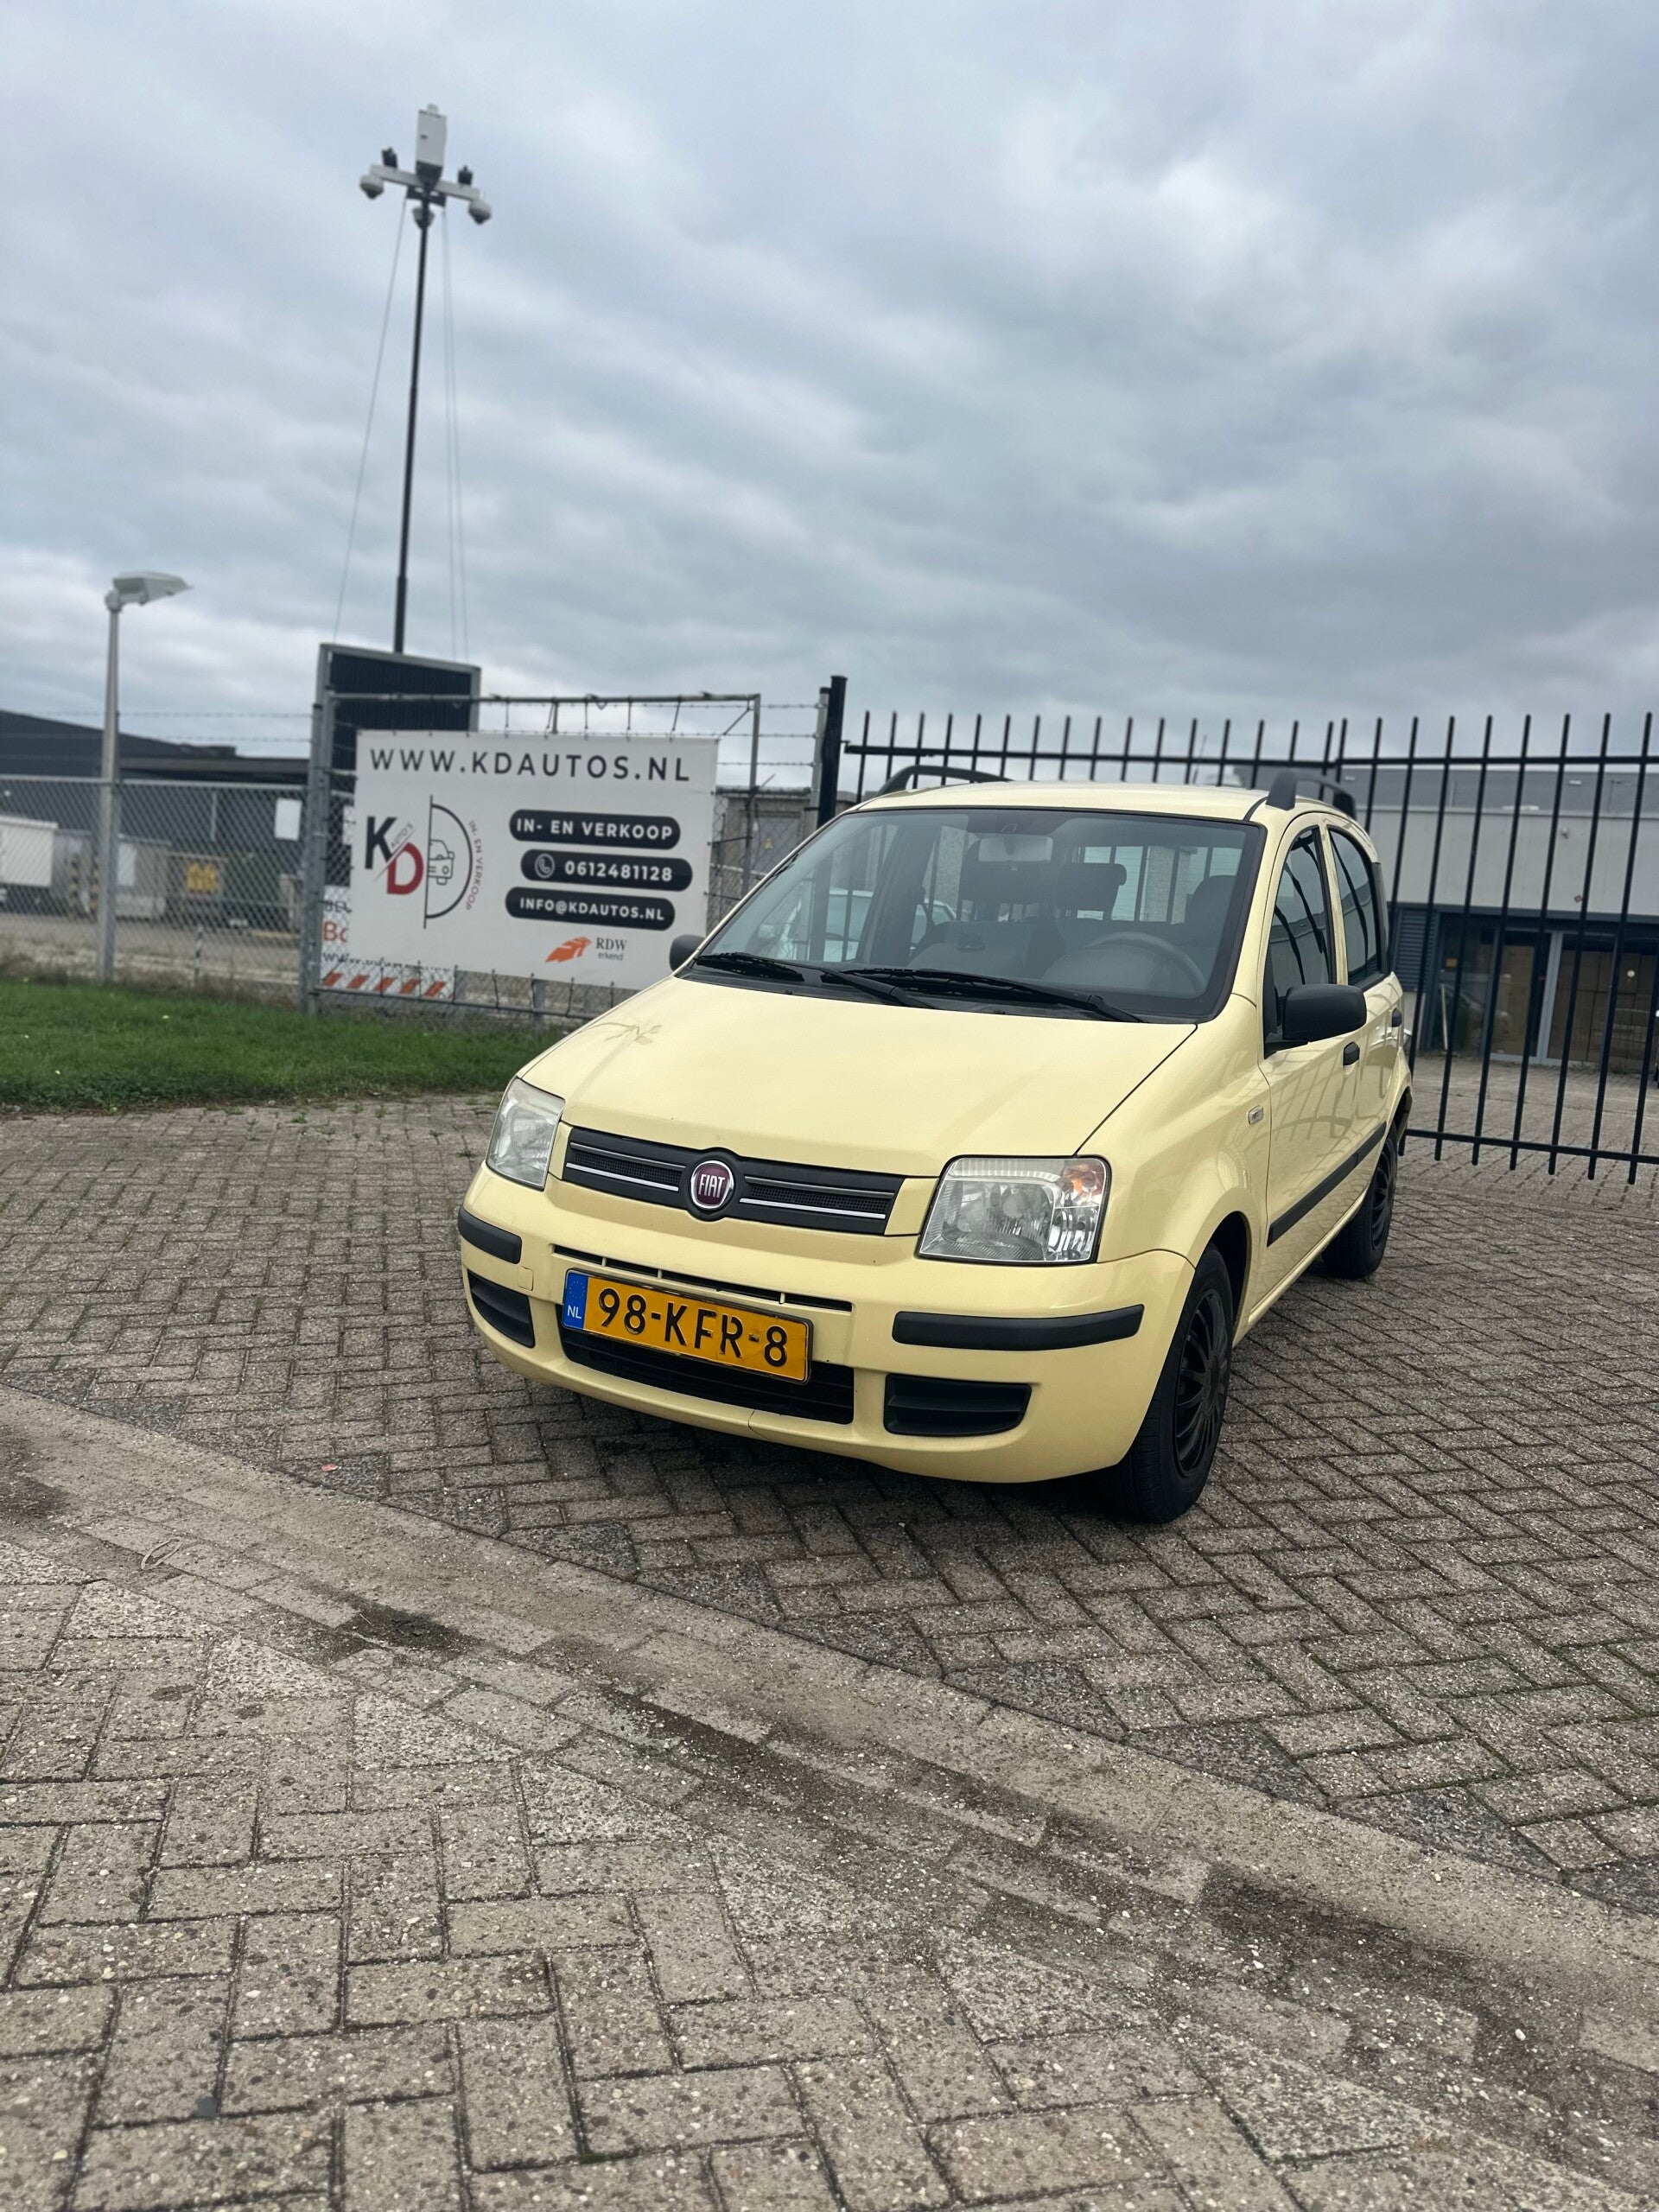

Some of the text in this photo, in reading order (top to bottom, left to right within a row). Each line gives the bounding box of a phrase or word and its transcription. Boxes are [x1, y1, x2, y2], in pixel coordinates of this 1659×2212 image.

[371, 748, 690, 782] WWW.KDAUTOS.NL
[517, 818, 673, 840] IN- EN VERKOOP
[564, 861, 673, 881] 0612481128
[465, 856, 484, 911] VERKOOP
[520, 898, 665, 921] INFO@KDAUTOS.NL
[595, 937, 627, 951] RDW
[598, 951, 624, 962] erkend
[698, 1173, 726, 1198] FIAT
[567, 1305, 582, 1319] NL
[598, 1287, 788, 1367] 98-KFR-8
